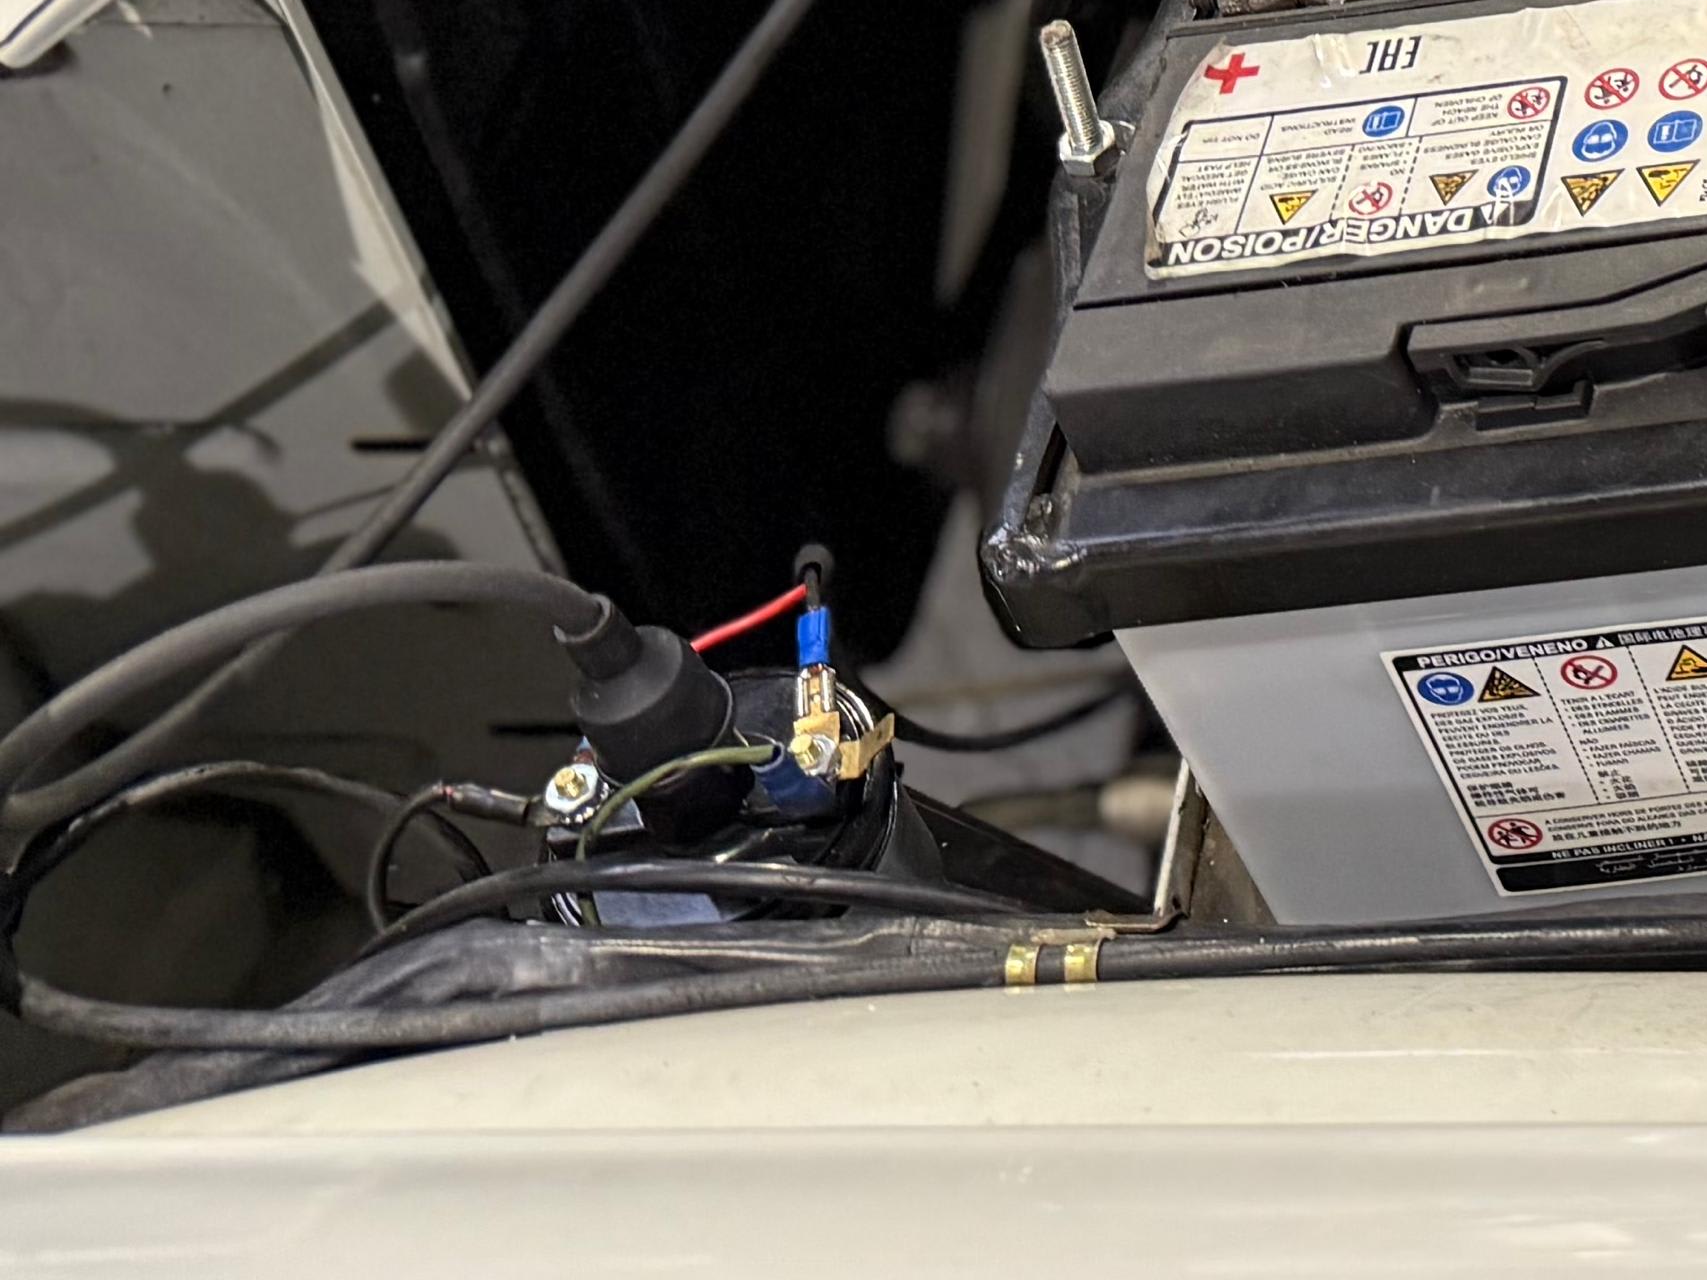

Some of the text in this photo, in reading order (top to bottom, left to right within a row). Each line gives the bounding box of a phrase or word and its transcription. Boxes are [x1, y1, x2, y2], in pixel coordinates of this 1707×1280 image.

[1165, 205, 1475, 265] DANGER/POISON
[1414, 638, 1590, 669] PERIGO/VENENO
[1602, 838, 1666, 852] INCLINER
